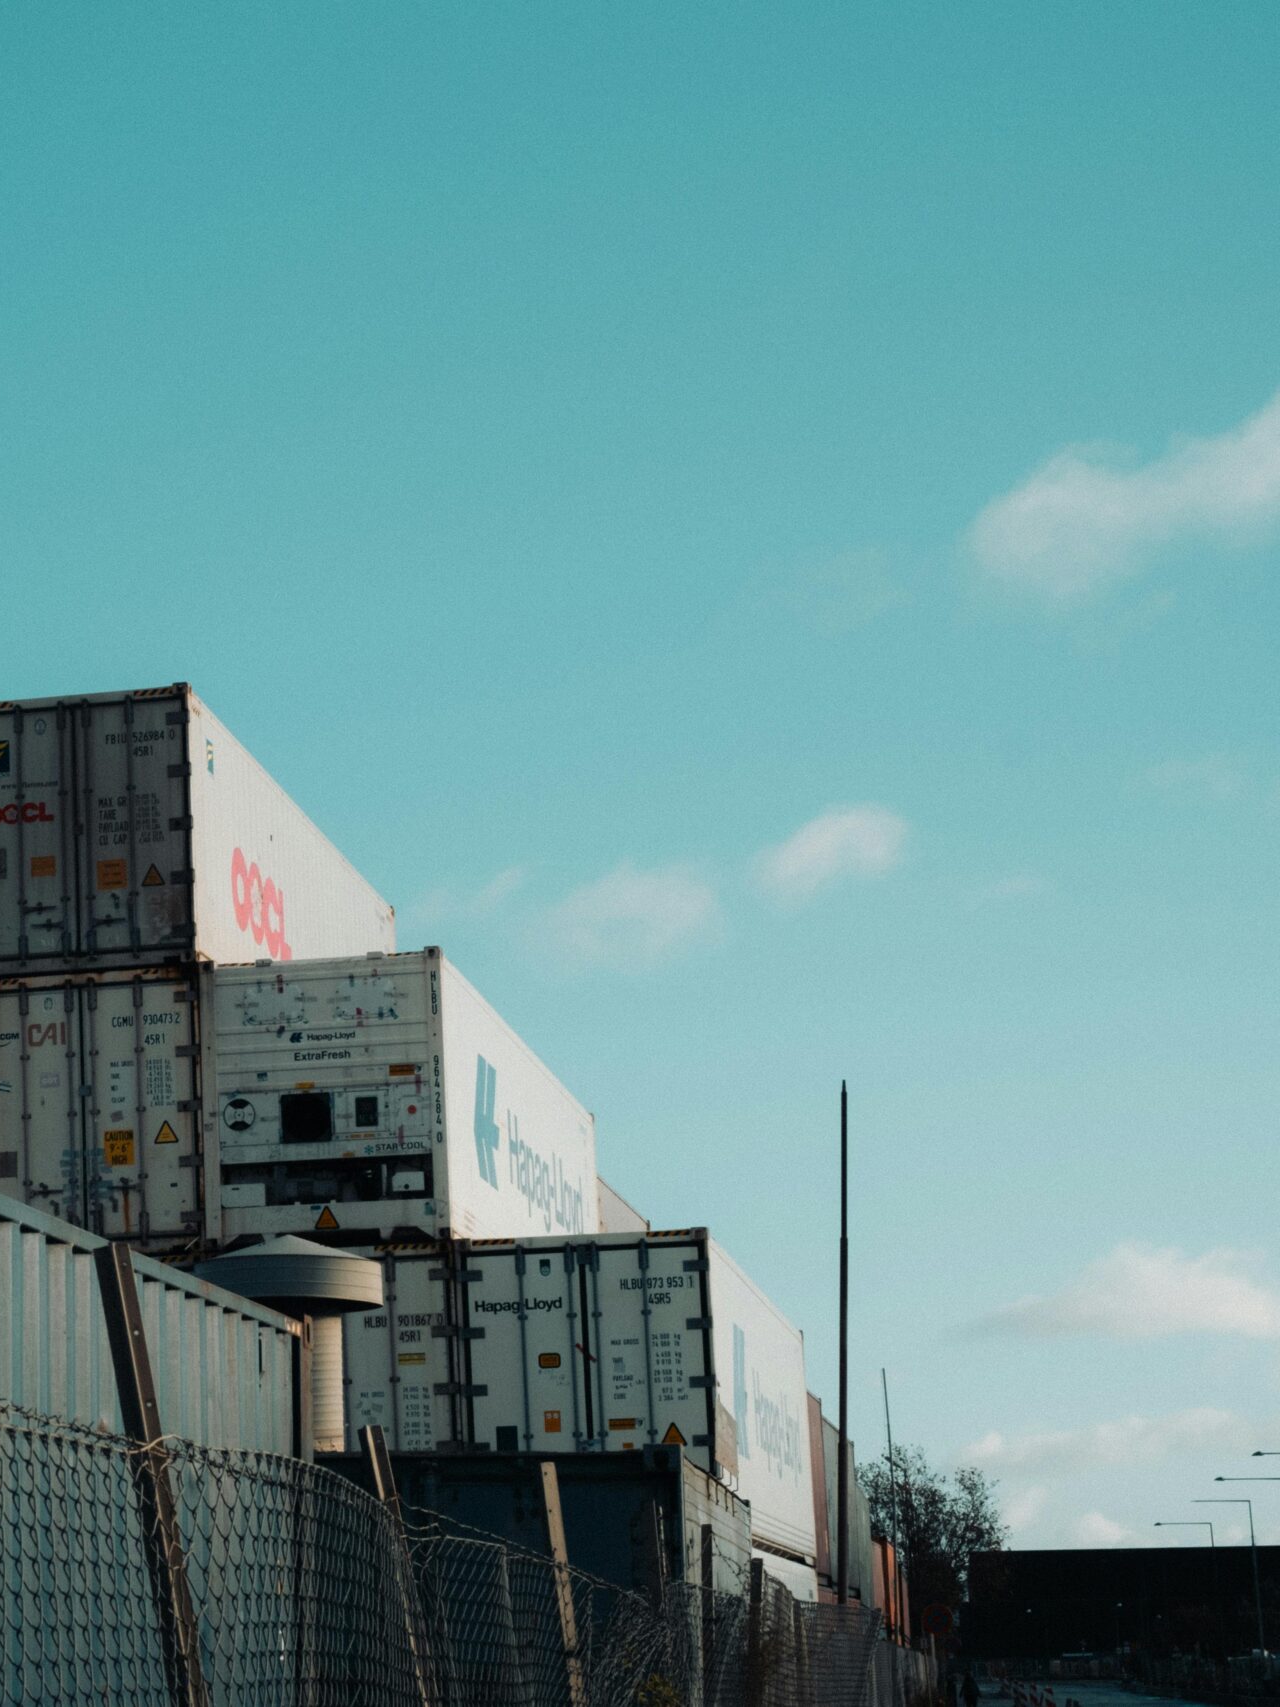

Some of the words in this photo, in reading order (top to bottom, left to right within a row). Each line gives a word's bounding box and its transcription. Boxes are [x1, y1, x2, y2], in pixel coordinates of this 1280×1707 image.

[105, 734, 128, 744] FBIU
[132, 731, 165, 743] 526984
[169, 730, 176, 740] 0
[133, 746, 154, 757] 45R1
[98, 797, 113, 808] MAX
[99, 809, 117, 820] TARE
[98, 822, 129, 833] PAYLOAD
[113, 833, 128, 845] CAP
[231, 847, 292, 962] OOCL
[430, 971, 439, 1015] HLBU
[112, 1016, 134, 1028] CGMU
[143, 1013, 173, 1025] 930473
[0, 1033, 20, 1041] CGM
[28, 1022, 67, 1047] CAI
[144, 1033, 166, 1045] 45R1
[307, 1032, 356, 1042] Hapag-Lloyd
[294, 1050, 351, 1061] ExtraFresh
[105, 1130, 134, 1142] CAUTION
[375, 1143, 398, 1151] STAR
[400, 1141, 426, 1150] COOL
[112, 1154, 128, 1165] HIGH
[507, 1108, 584, 1235] Hapag-Lloyd
[620, 1278, 643, 1290] HLBU
[646, 1277, 664, 1289] 973
[666, 1276, 684, 1288] 953
[648, 1292, 672, 1304] 45R5
[364, 1316, 387, 1328] HLBU
[398, 1314, 432, 1327] 901867
[400, 1330, 421, 1343] 45R1
